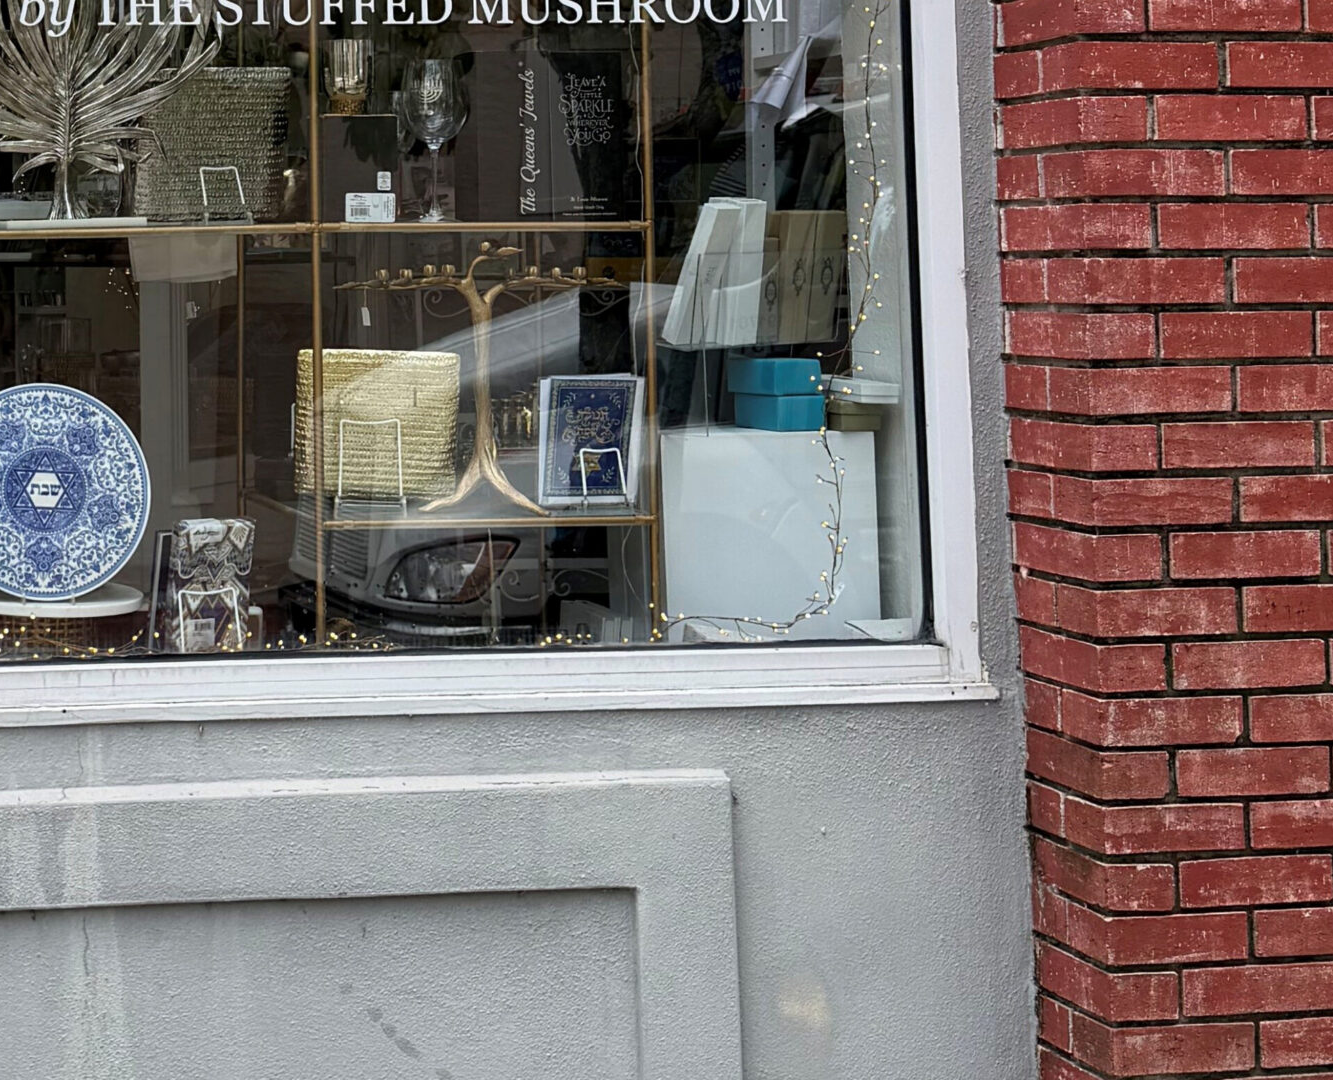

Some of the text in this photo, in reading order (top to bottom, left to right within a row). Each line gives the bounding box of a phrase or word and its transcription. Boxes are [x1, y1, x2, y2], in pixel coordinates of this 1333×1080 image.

[518, 68, 538, 122] Jewels
[519, 187, 537, 215] The
[29, 483, 61, 497] שבת
